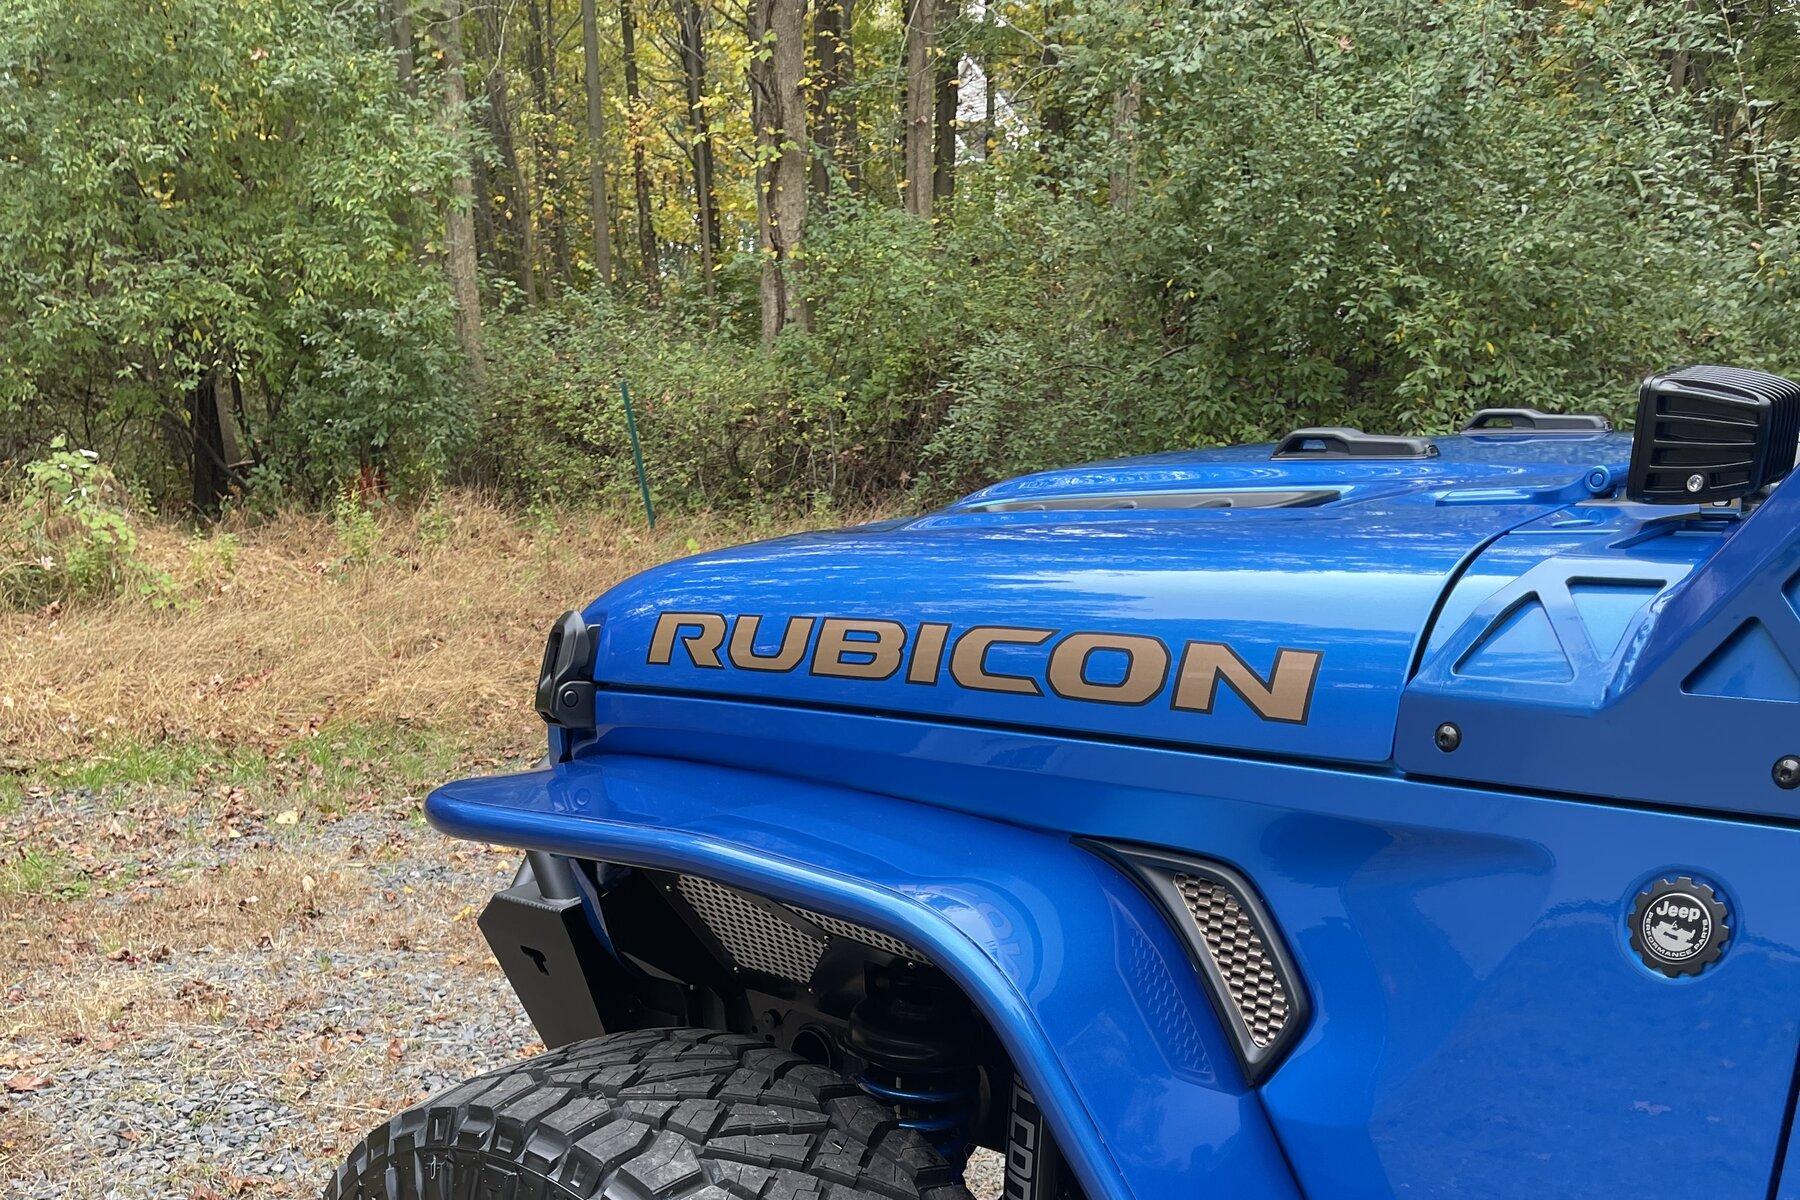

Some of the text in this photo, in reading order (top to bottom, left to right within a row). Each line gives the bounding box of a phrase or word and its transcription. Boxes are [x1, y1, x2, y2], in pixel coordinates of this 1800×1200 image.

[647, 612, 1325, 726] RUBICON
[1645, 911, 1709, 957] PERFORMANCE PARTS
[1656, 901, 1701, 922] Jeep
